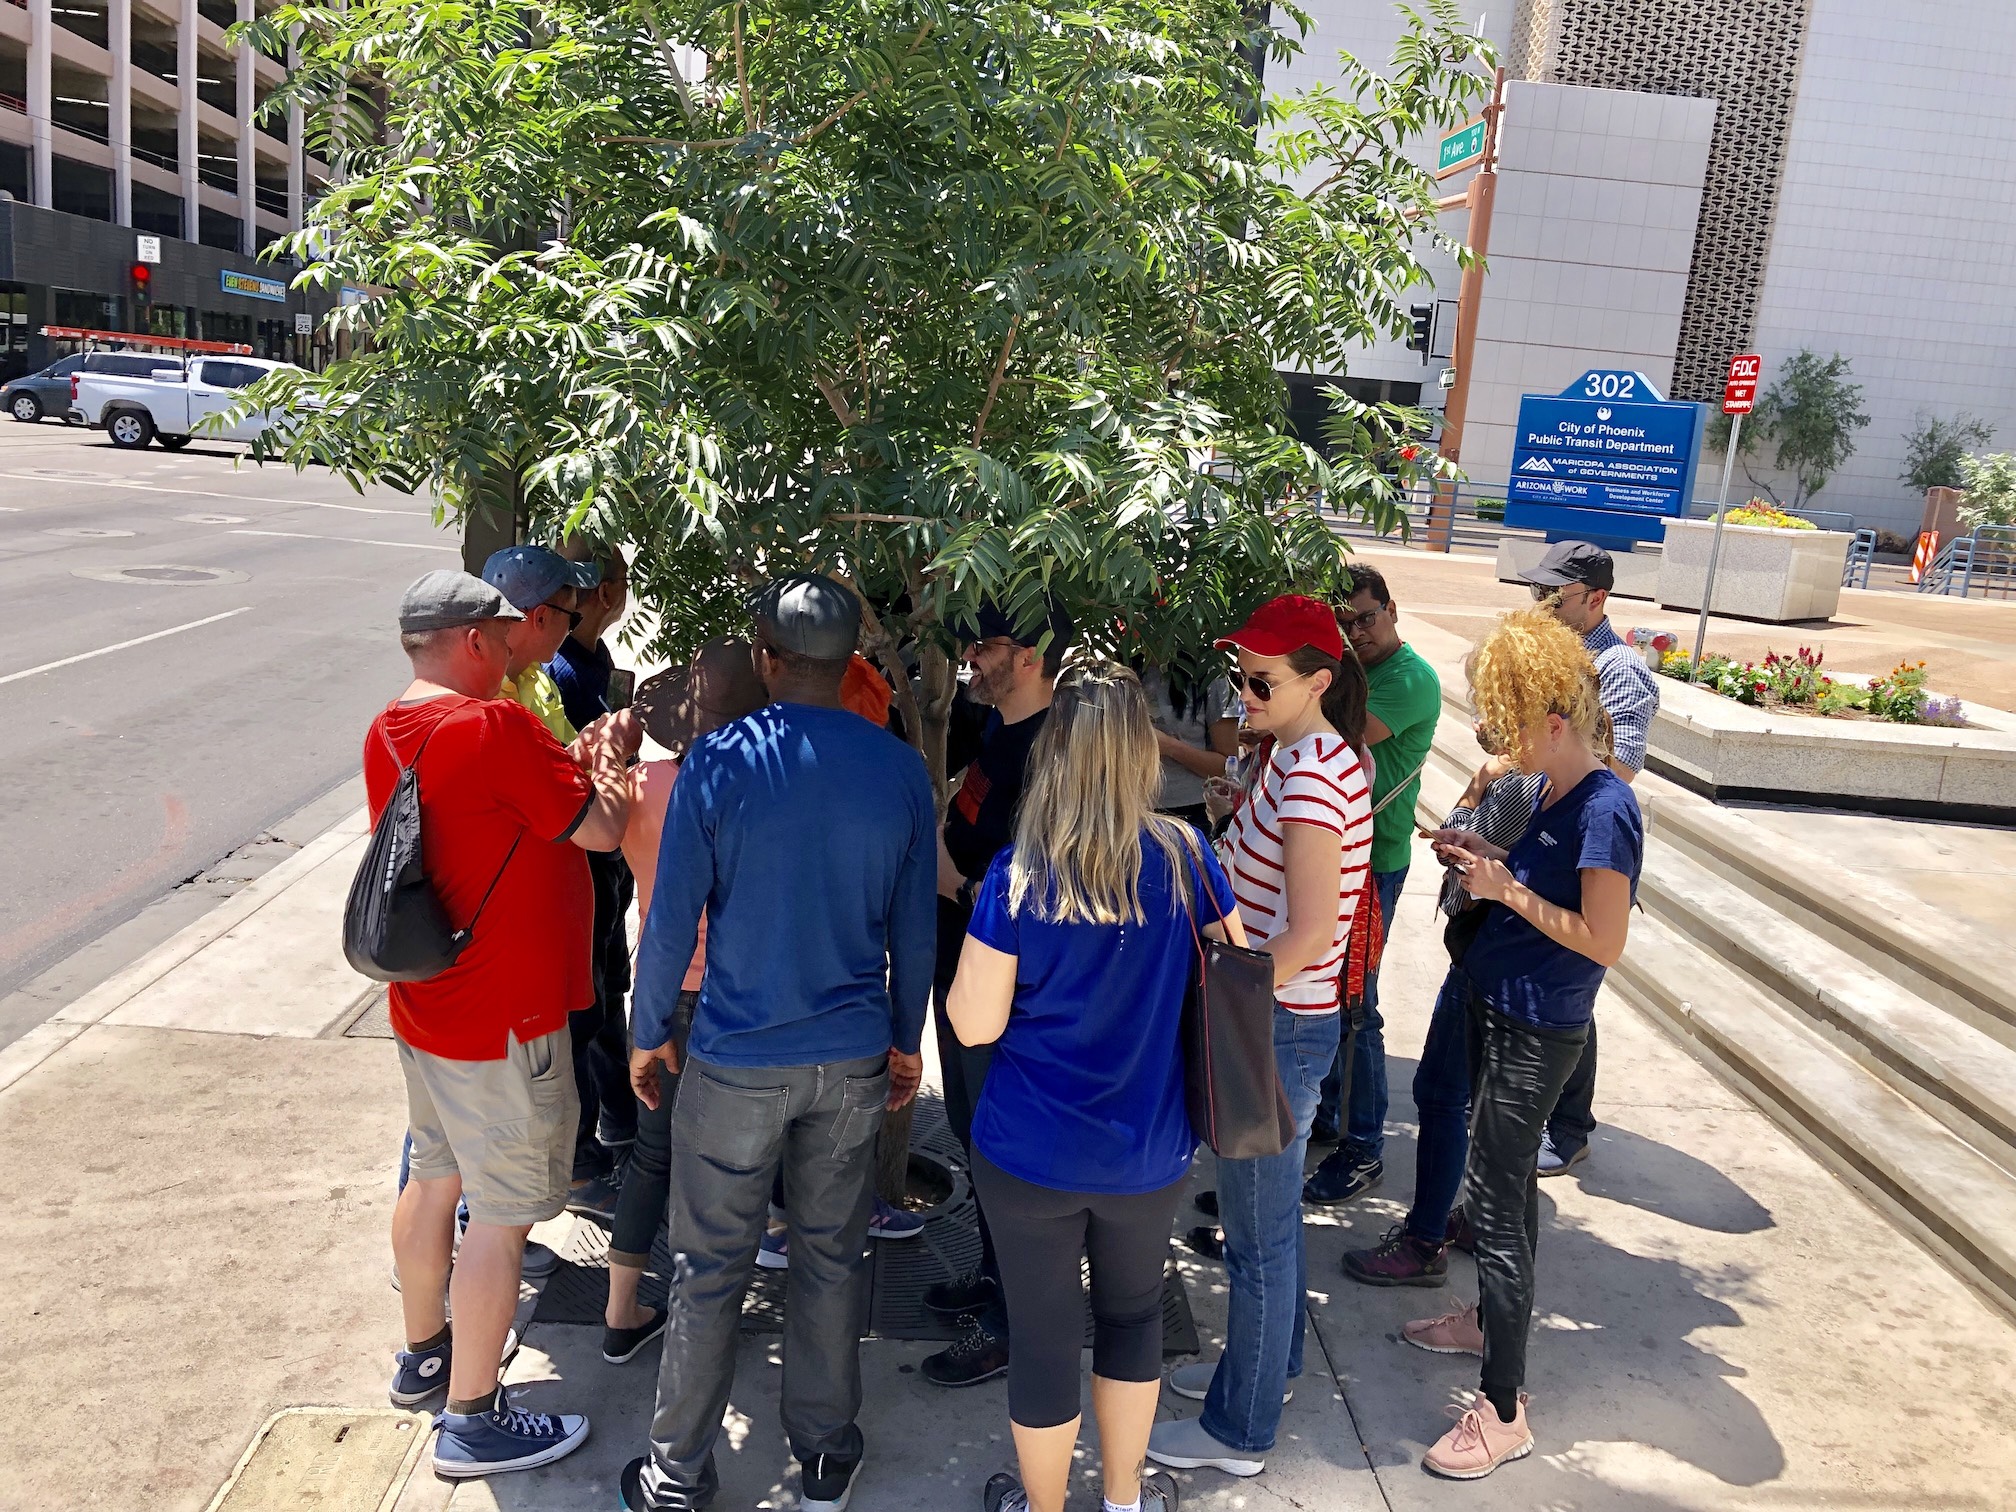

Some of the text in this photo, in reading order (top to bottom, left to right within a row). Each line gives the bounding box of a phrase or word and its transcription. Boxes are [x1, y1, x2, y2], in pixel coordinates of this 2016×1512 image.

[1443, 141, 1465, 161] 1st Ave.
[297, 324, 310, 332] 25
[1584, 373, 1635, 399] 302
[1735, 389, 1747, 398] WET
[1558, 421, 1646, 438] City of Phoenix
[1528, 433, 1675, 455] Public Transit Department
[1552, 458, 1678, 474] MARICOPA ASSOCIATION
[1579, 468, 1658, 481] GOVERNMENTS
[1605, 486, 1630, 494] Business
[1642, 490, 1671, 498] Workforce
[1609, 493, 1645, 502] Development
